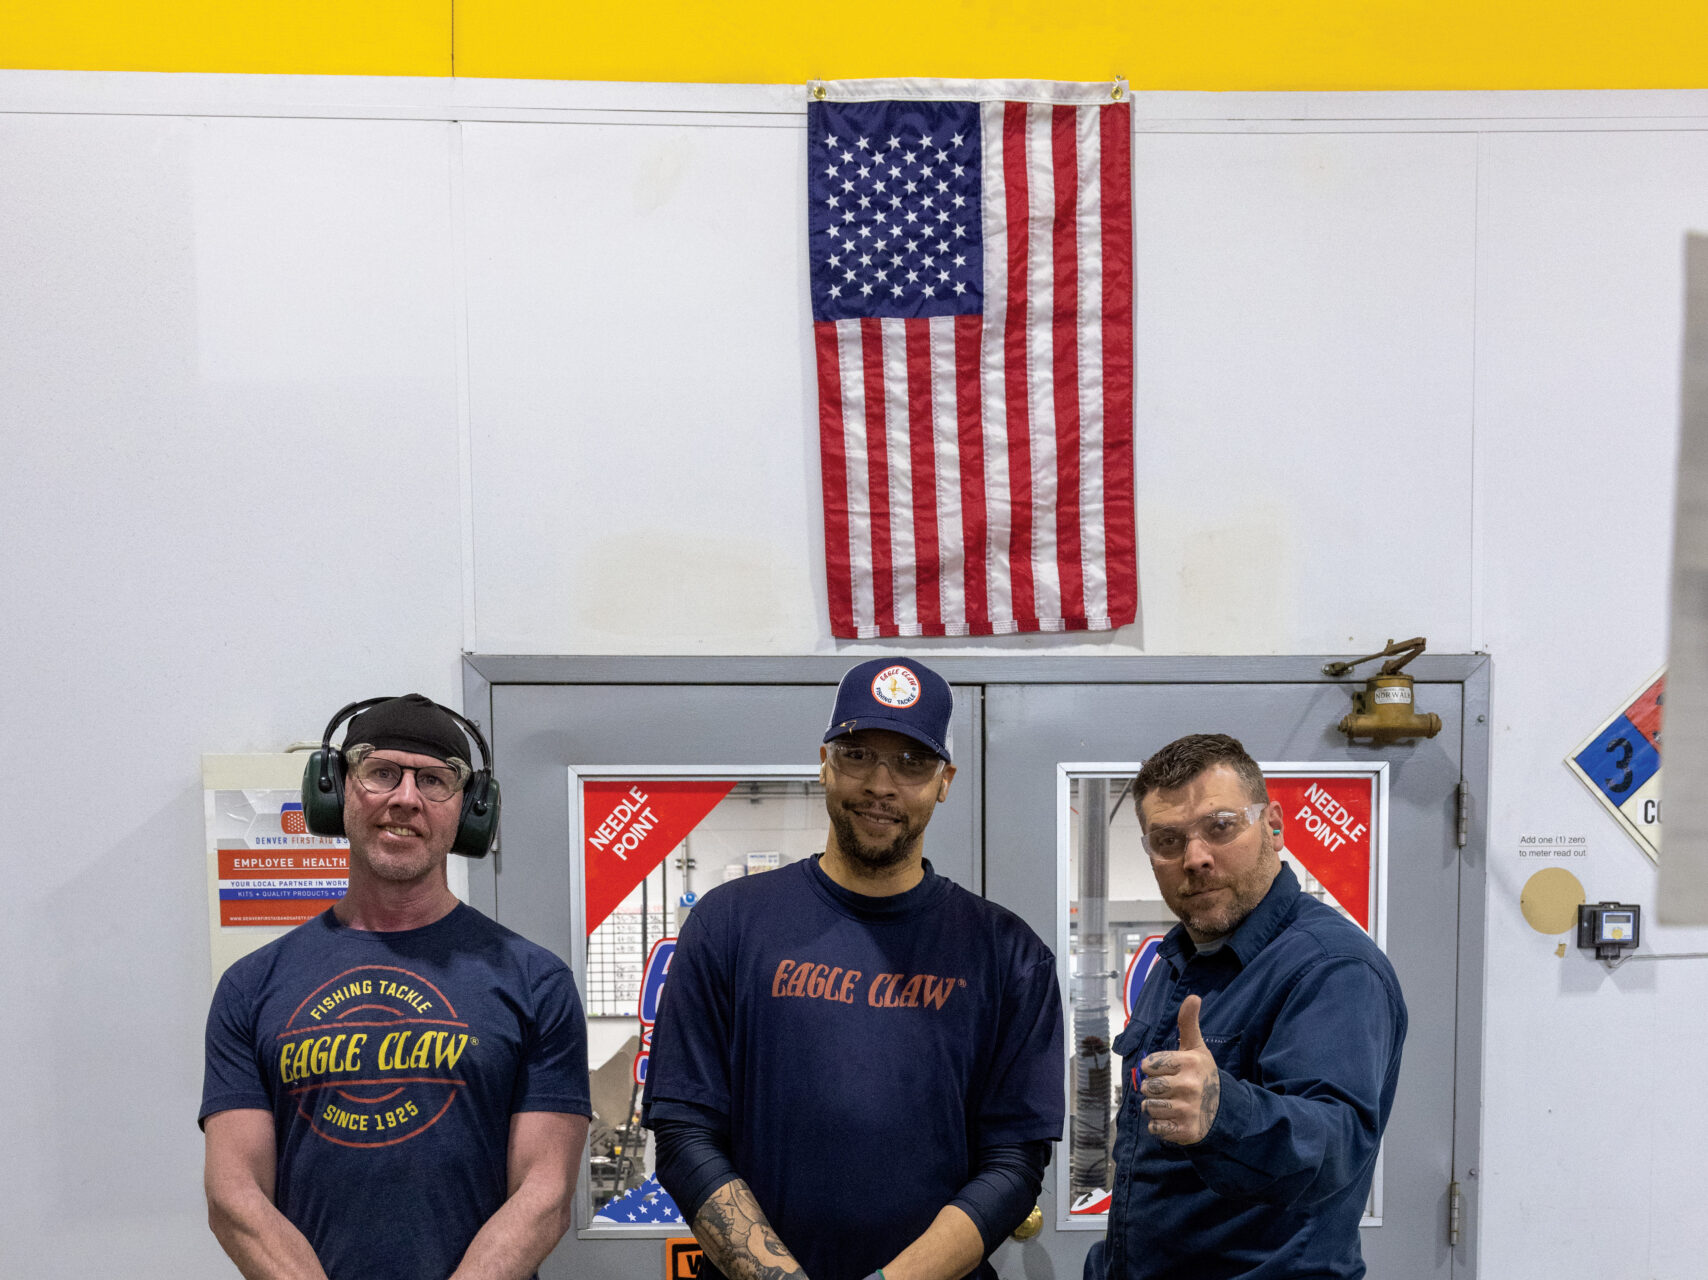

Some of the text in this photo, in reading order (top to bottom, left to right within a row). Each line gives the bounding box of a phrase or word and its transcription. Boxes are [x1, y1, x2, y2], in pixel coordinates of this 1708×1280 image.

[876, 687, 916, 704] FISHING TACKLE
[880, 669, 900, 681] EAGLE
[1605, 737, 1633, 793] 3
[588, 785, 648, 851] NEEDLE
[1294, 805, 1346, 852] POINT
[1304, 782, 1367, 842] NEEDLE
[255, 836, 288, 845] DENVER
[291, 836, 315, 845] FIRST
[612, 806, 659, 861] POINT
[1520, 836, 1536, 844] Add
[1555, 836, 1566, 844] (1)
[233, 857, 347, 868] EMPLOYEE HEALTH
[310, 980, 433, 1020] FISHING TACKLE
[772, 959, 862, 1004] EAGLE
[280, 1033, 368, 1084] EAGLE
[322, 1100, 419, 1131] SINCE 1925
